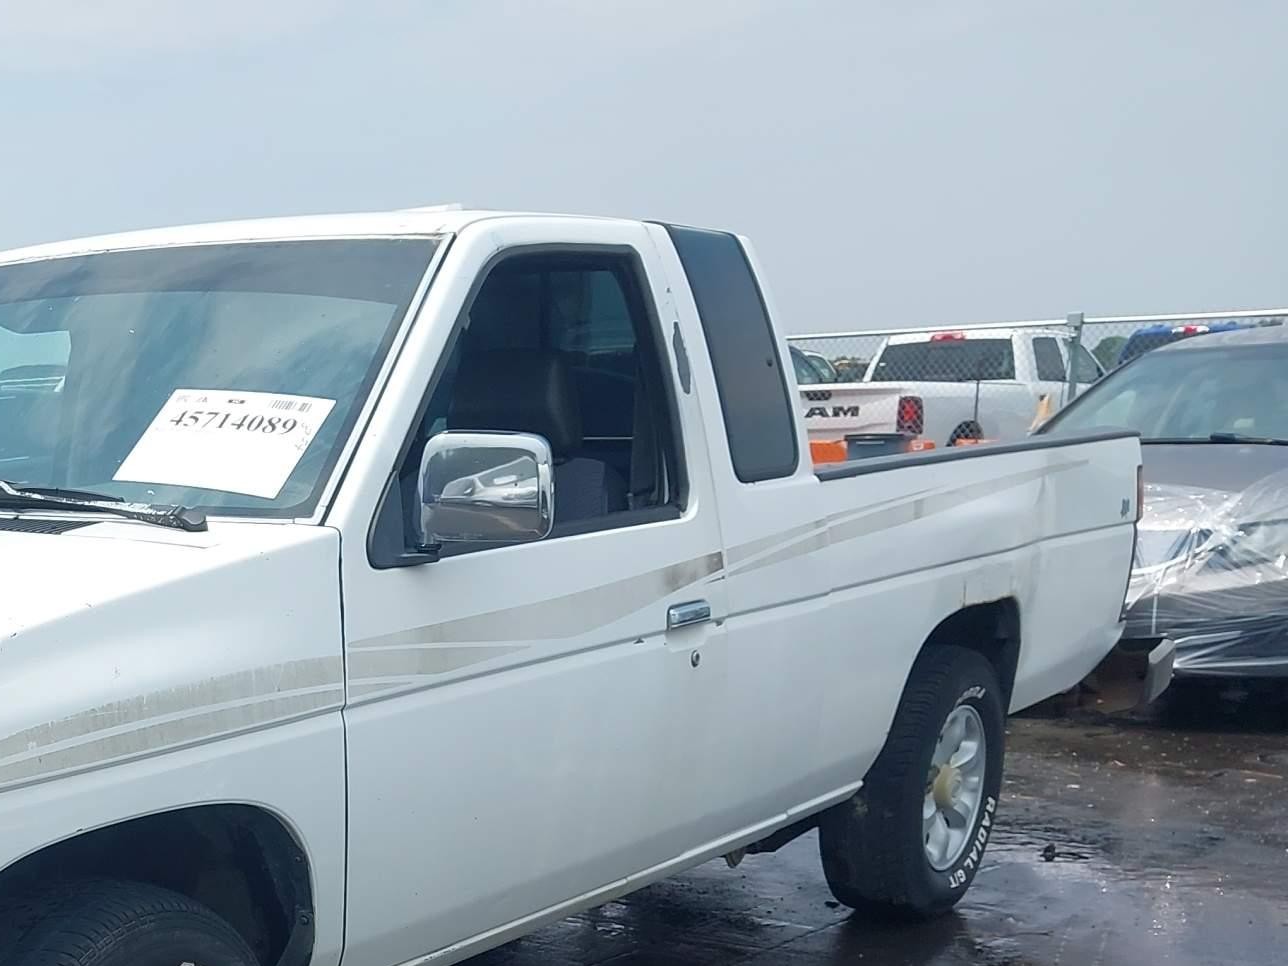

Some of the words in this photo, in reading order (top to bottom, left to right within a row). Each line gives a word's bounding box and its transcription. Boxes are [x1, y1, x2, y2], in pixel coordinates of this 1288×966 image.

[168, 409, 298, 435] 45714089
[804, 406, 860, 418] AM
[963, 796, 996, 869] RADIAL
[948, 869, 967, 888] G/T
